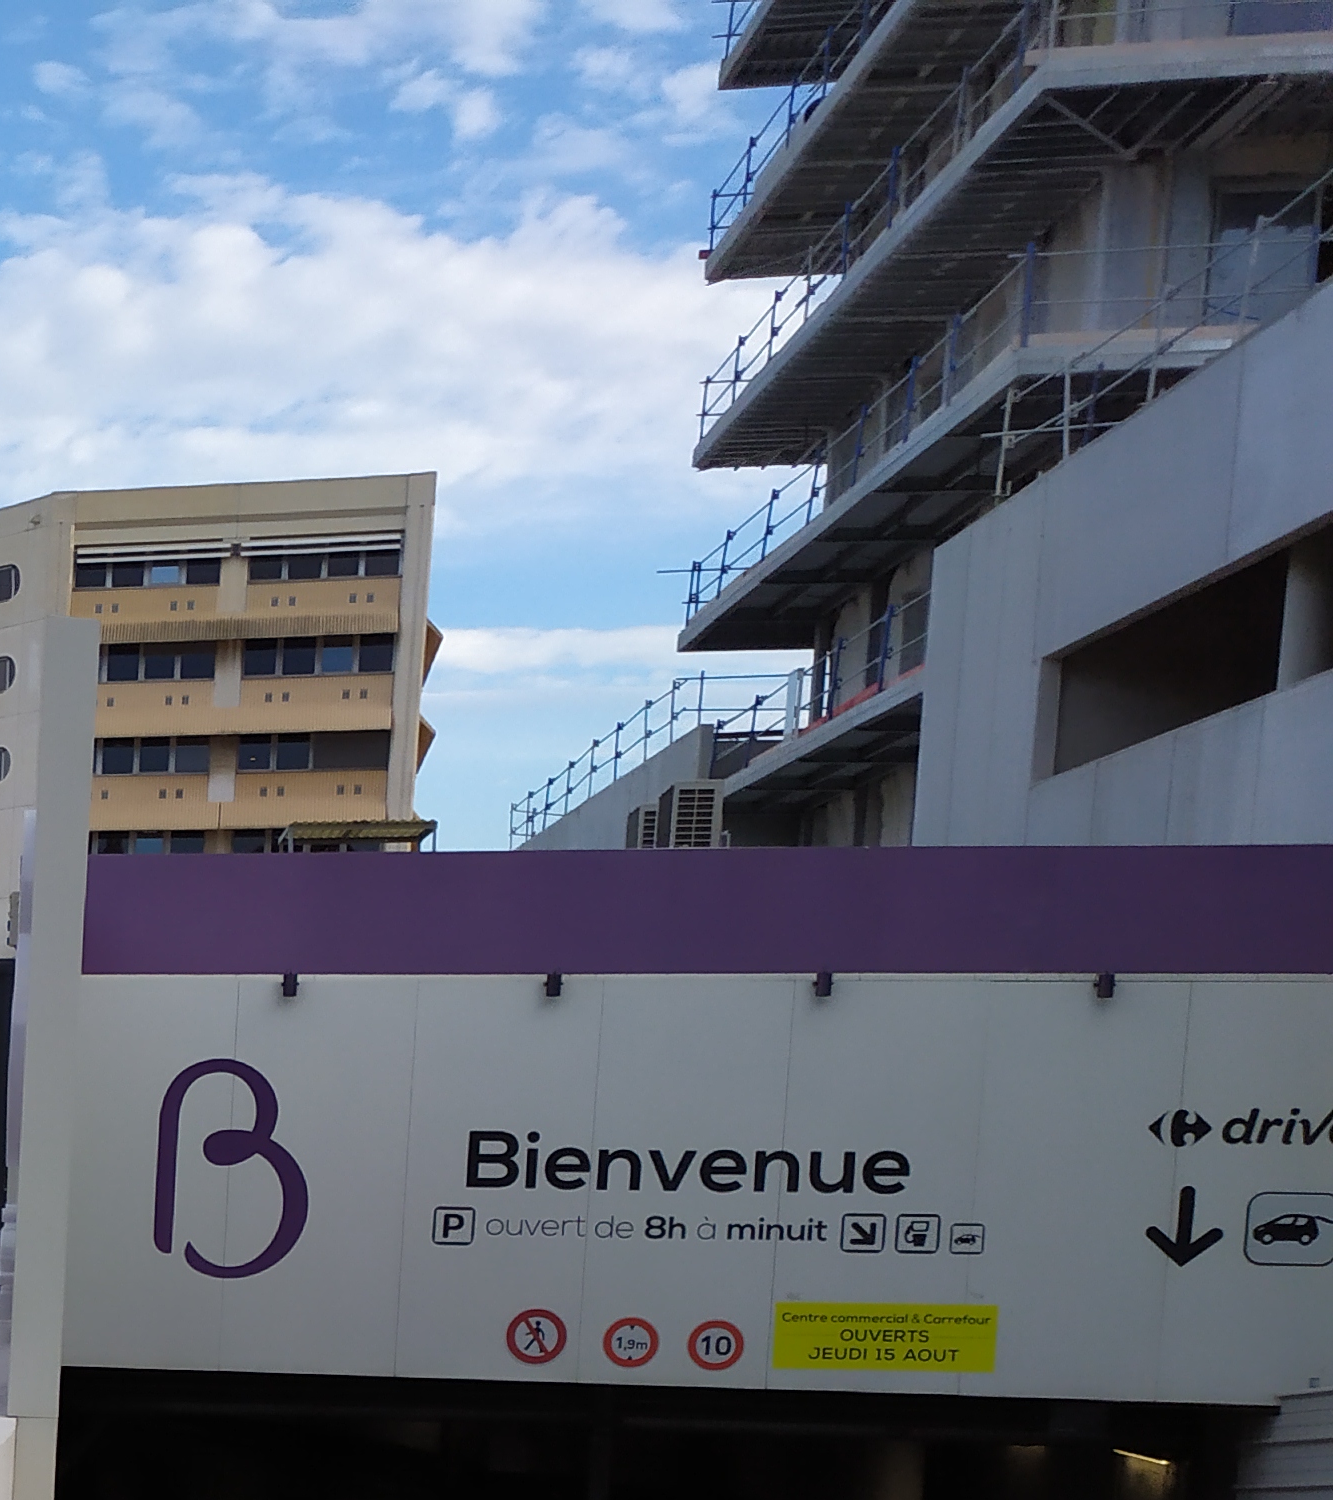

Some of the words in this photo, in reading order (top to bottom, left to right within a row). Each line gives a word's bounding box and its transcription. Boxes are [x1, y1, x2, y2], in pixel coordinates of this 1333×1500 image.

[1222, 1108, 1333, 1146] driv
[465, 1130, 911, 1194] Bienvenue
[442, 1213, 464, 1239] P
[485, 1215, 587, 1237] ouvert
[594, 1215, 634, 1239] de
[644, 1215, 686, 1240] 8h
[696, 1216, 716, 1240] à
[727, 1217, 828, 1242] minuit
[782, 1312, 828, 1323] Centre
[830, 1313, 909, 1324] commercial
[911, 1314, 921, 1324] &
[923, 1314, 992, 1325] Carrefour
[616, 1336, 648, 1351] 1,9m
[840, 1328, 930, 1343] OUVERTS
[701, 1335, 732, 1356] 10
[808, 1347, 867, 1361] JEUDI
[875, 1348, 895, 1361] 15
[902, 1348, 960, 1363] AOUT
